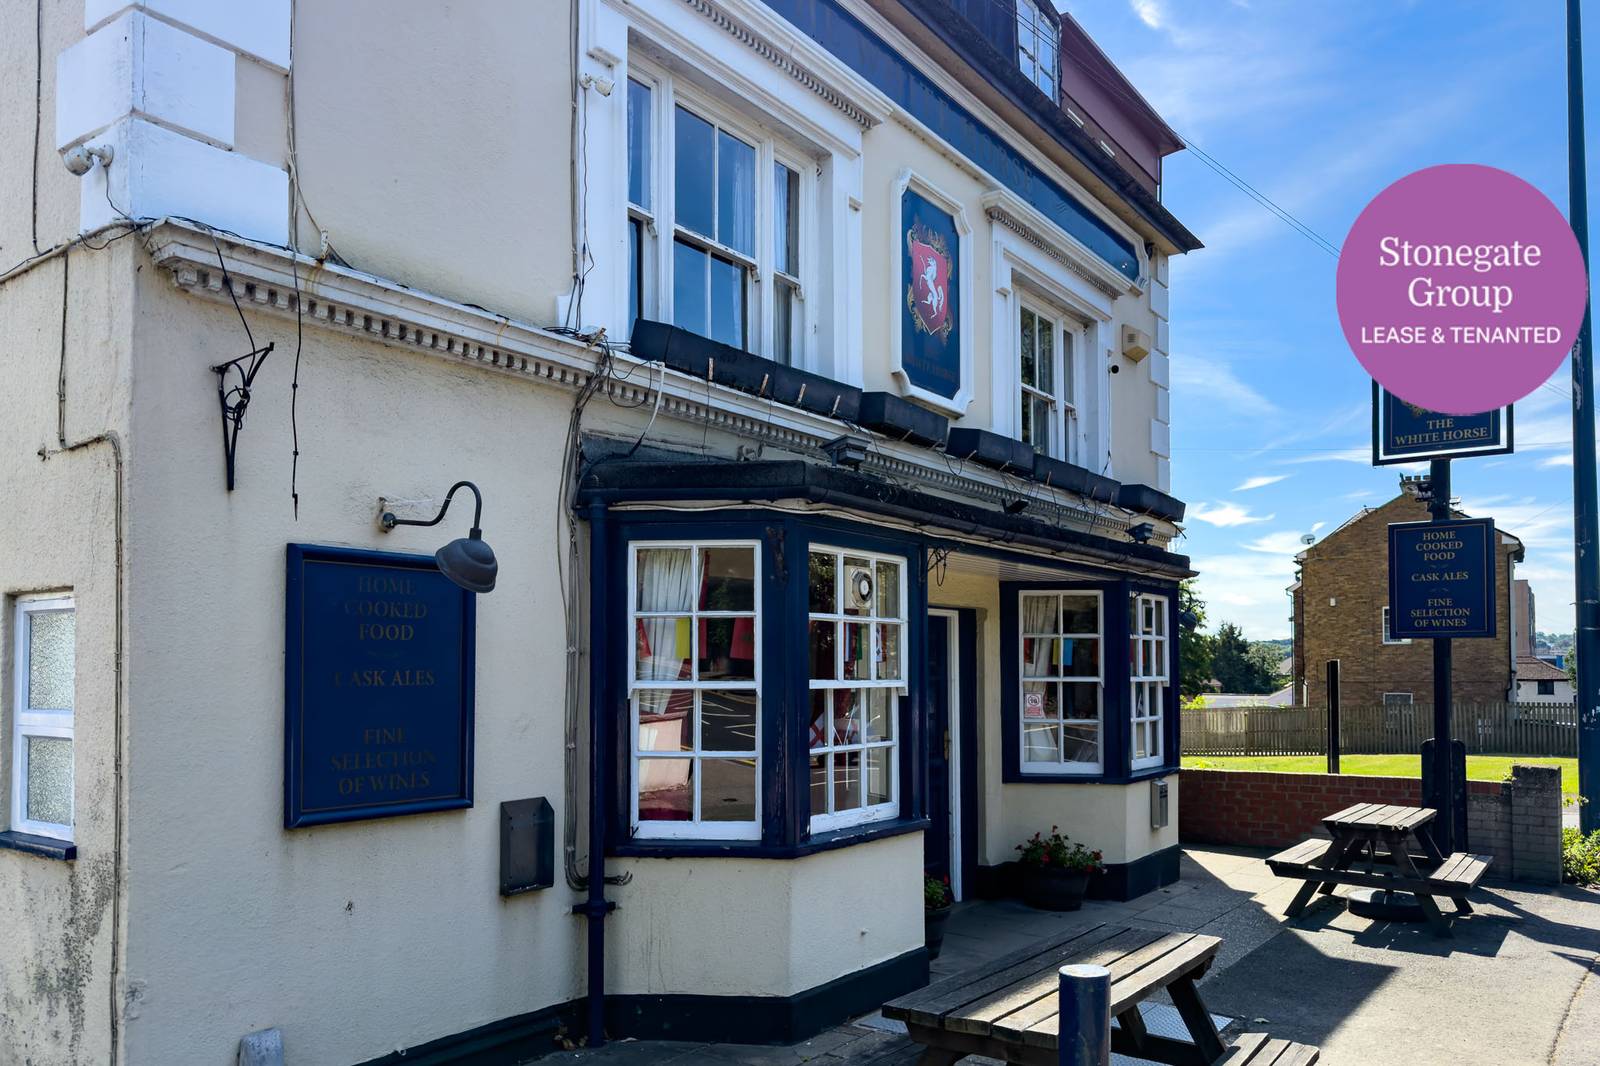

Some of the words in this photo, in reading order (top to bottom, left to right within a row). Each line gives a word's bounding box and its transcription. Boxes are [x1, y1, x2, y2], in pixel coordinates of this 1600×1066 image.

[1426, 418, 1455, 430] THE
[1394, 431, 1440, 446] WHITE
[1443, 426, 1488, 441] HORSE
[1423, 530, 1457, 541] HOME
[1415, 540, 1464, 552] COOKED
[1423, 551, 1456, 561] FOOD
[1411, 572, 1440, 582] CASK
[1442, 571, 1469, 581] ALES
[1427, 598, 1454, 607] FINE
[1410, 607, 1471, 618] SELECTION
[1414, 618, 1429, 628] OF
[1431, 618, 1467, 628] WINES
[359, 624, 414, 641] FOOD
[391, 669, 435, 686] ALES
[338, 776, 365, 796] OF
